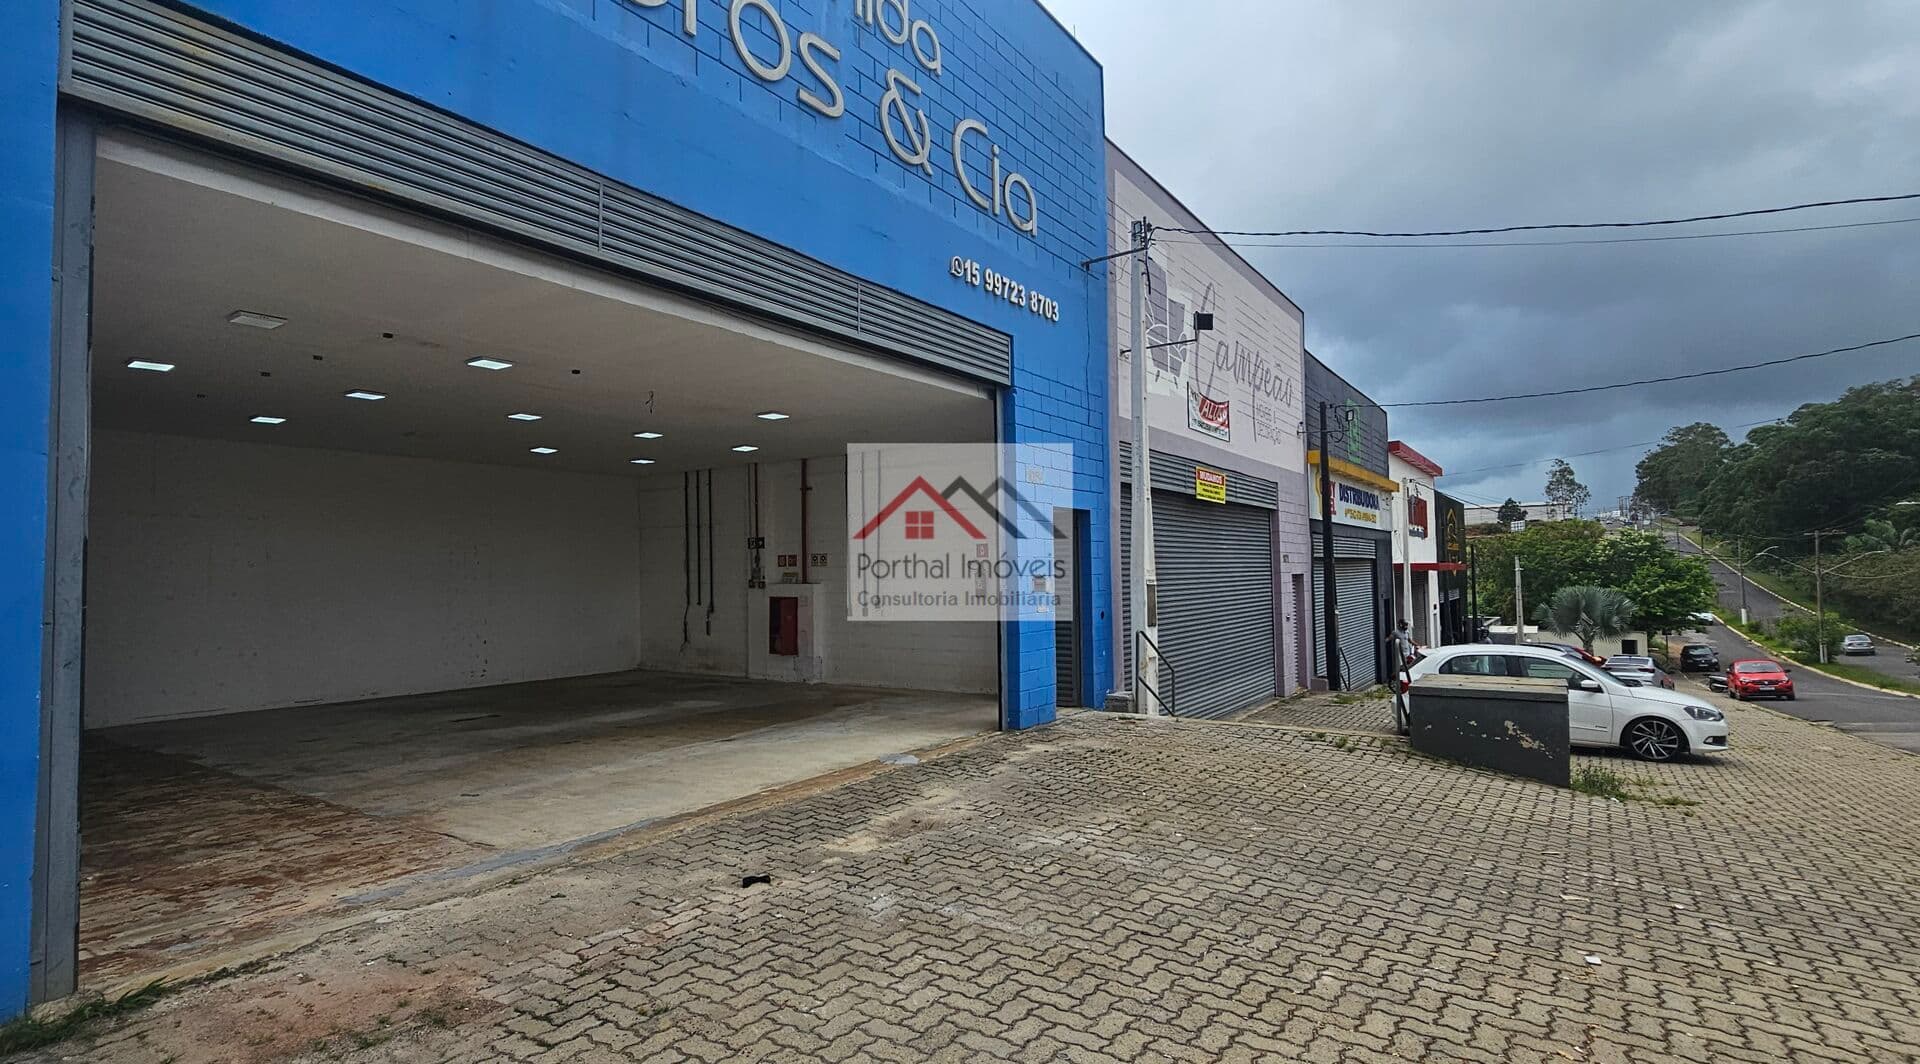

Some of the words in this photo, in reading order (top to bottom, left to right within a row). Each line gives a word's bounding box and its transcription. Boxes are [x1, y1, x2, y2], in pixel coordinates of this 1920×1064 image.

[854, 0, 942, 76] da
[880, 68, 933, 175] &
[952, 118, 1038, 236] Cia
[963, 258, 981, 287] 15
[985, 268, 1026, 307] 99723
[1029, 290, 1060, 322] 8703
